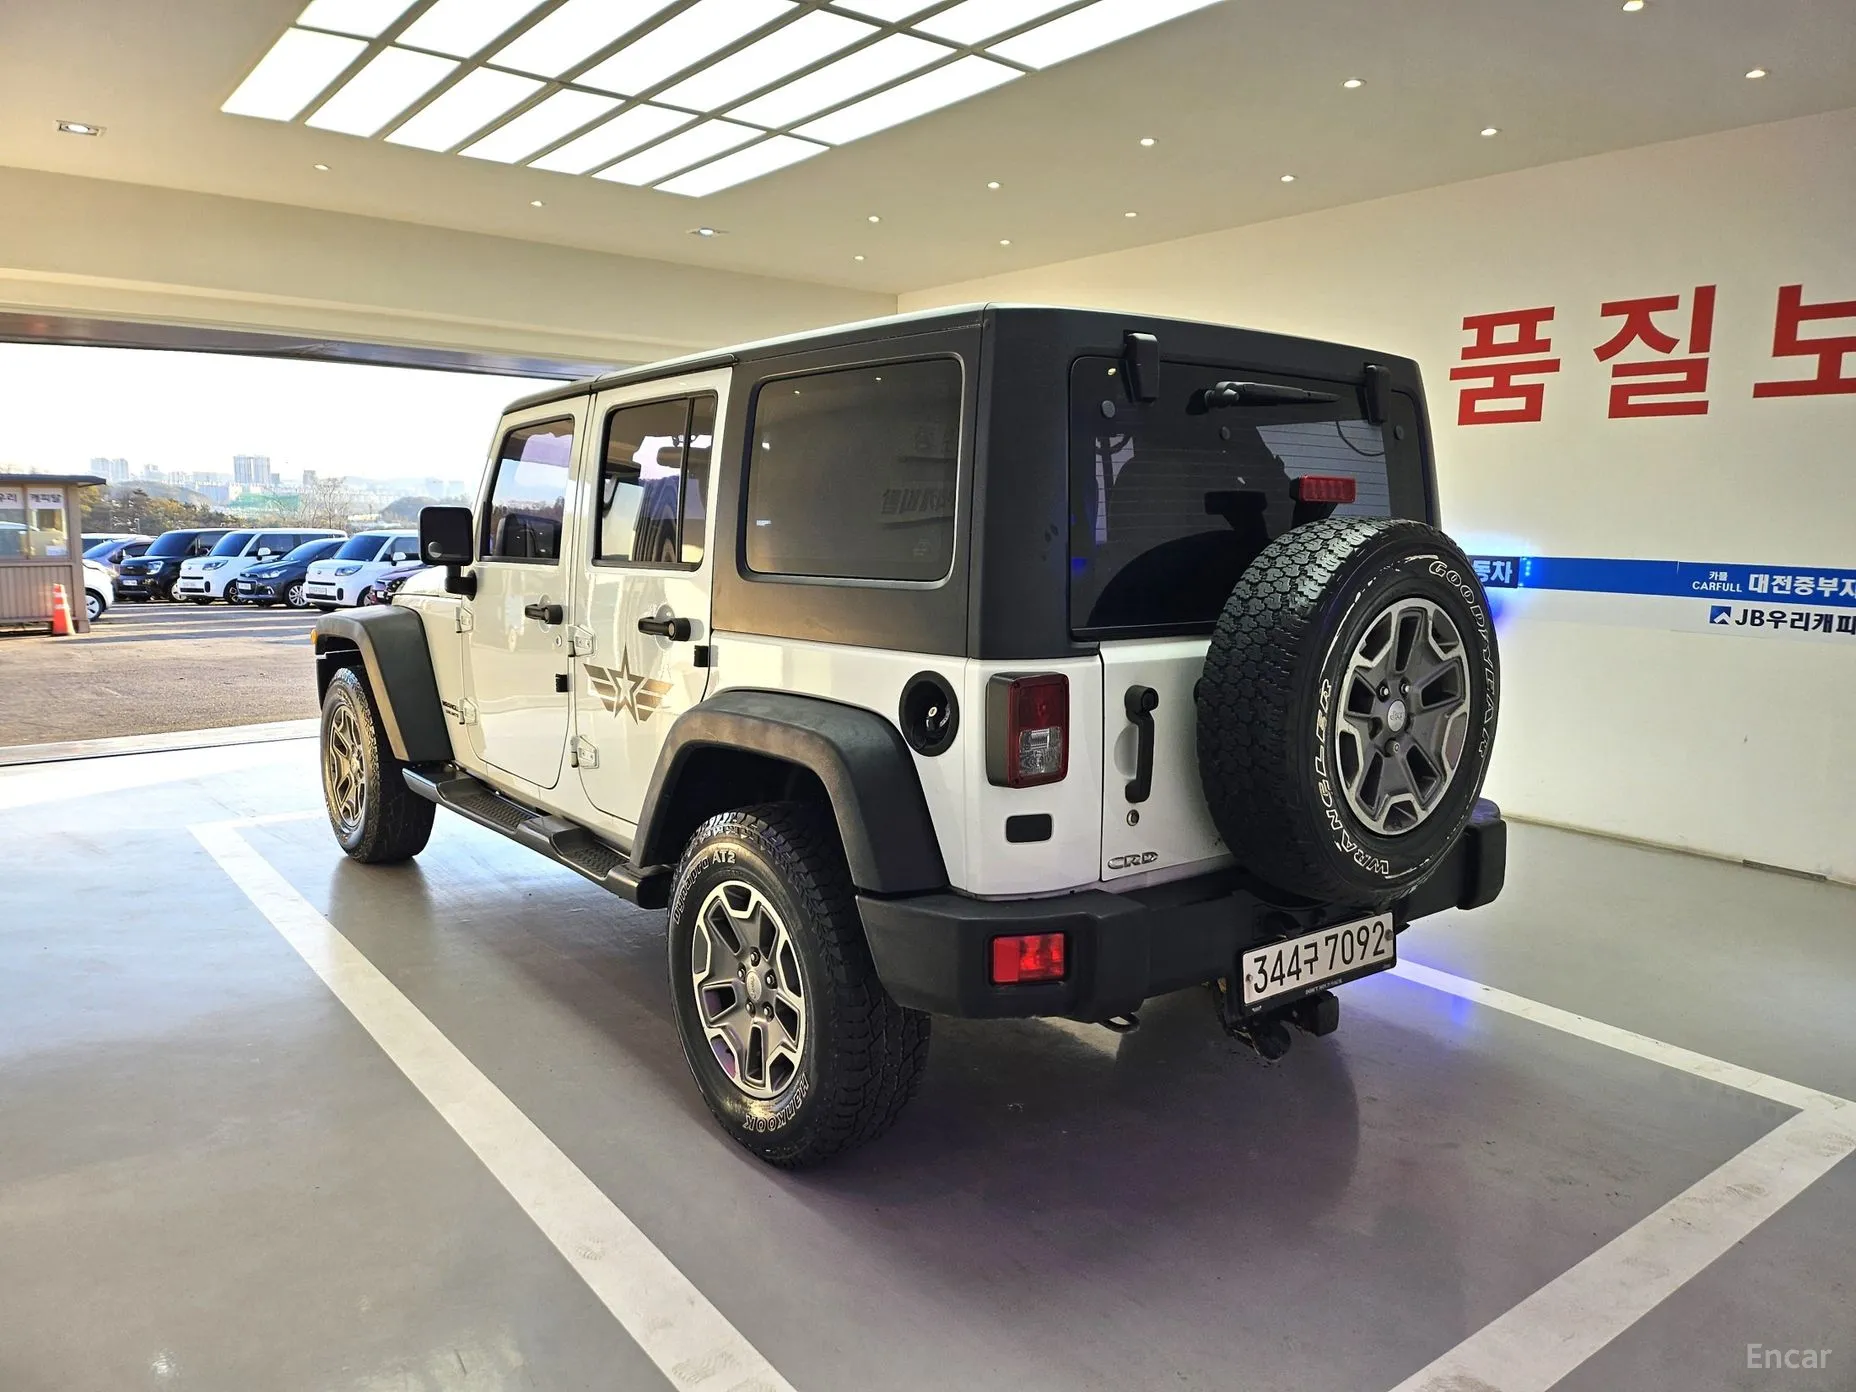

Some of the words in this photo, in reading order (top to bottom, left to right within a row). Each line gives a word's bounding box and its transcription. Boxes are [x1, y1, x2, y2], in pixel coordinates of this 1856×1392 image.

[1692, 581, 1743, 593] CARFULL
[1428, 560, 1495, 759] GOODYEAR
[1315, 678, 1390, 876] WRANGLER
[712, 850, 737, 865] AT2
[1107, 851, 1159, 870] CRD
